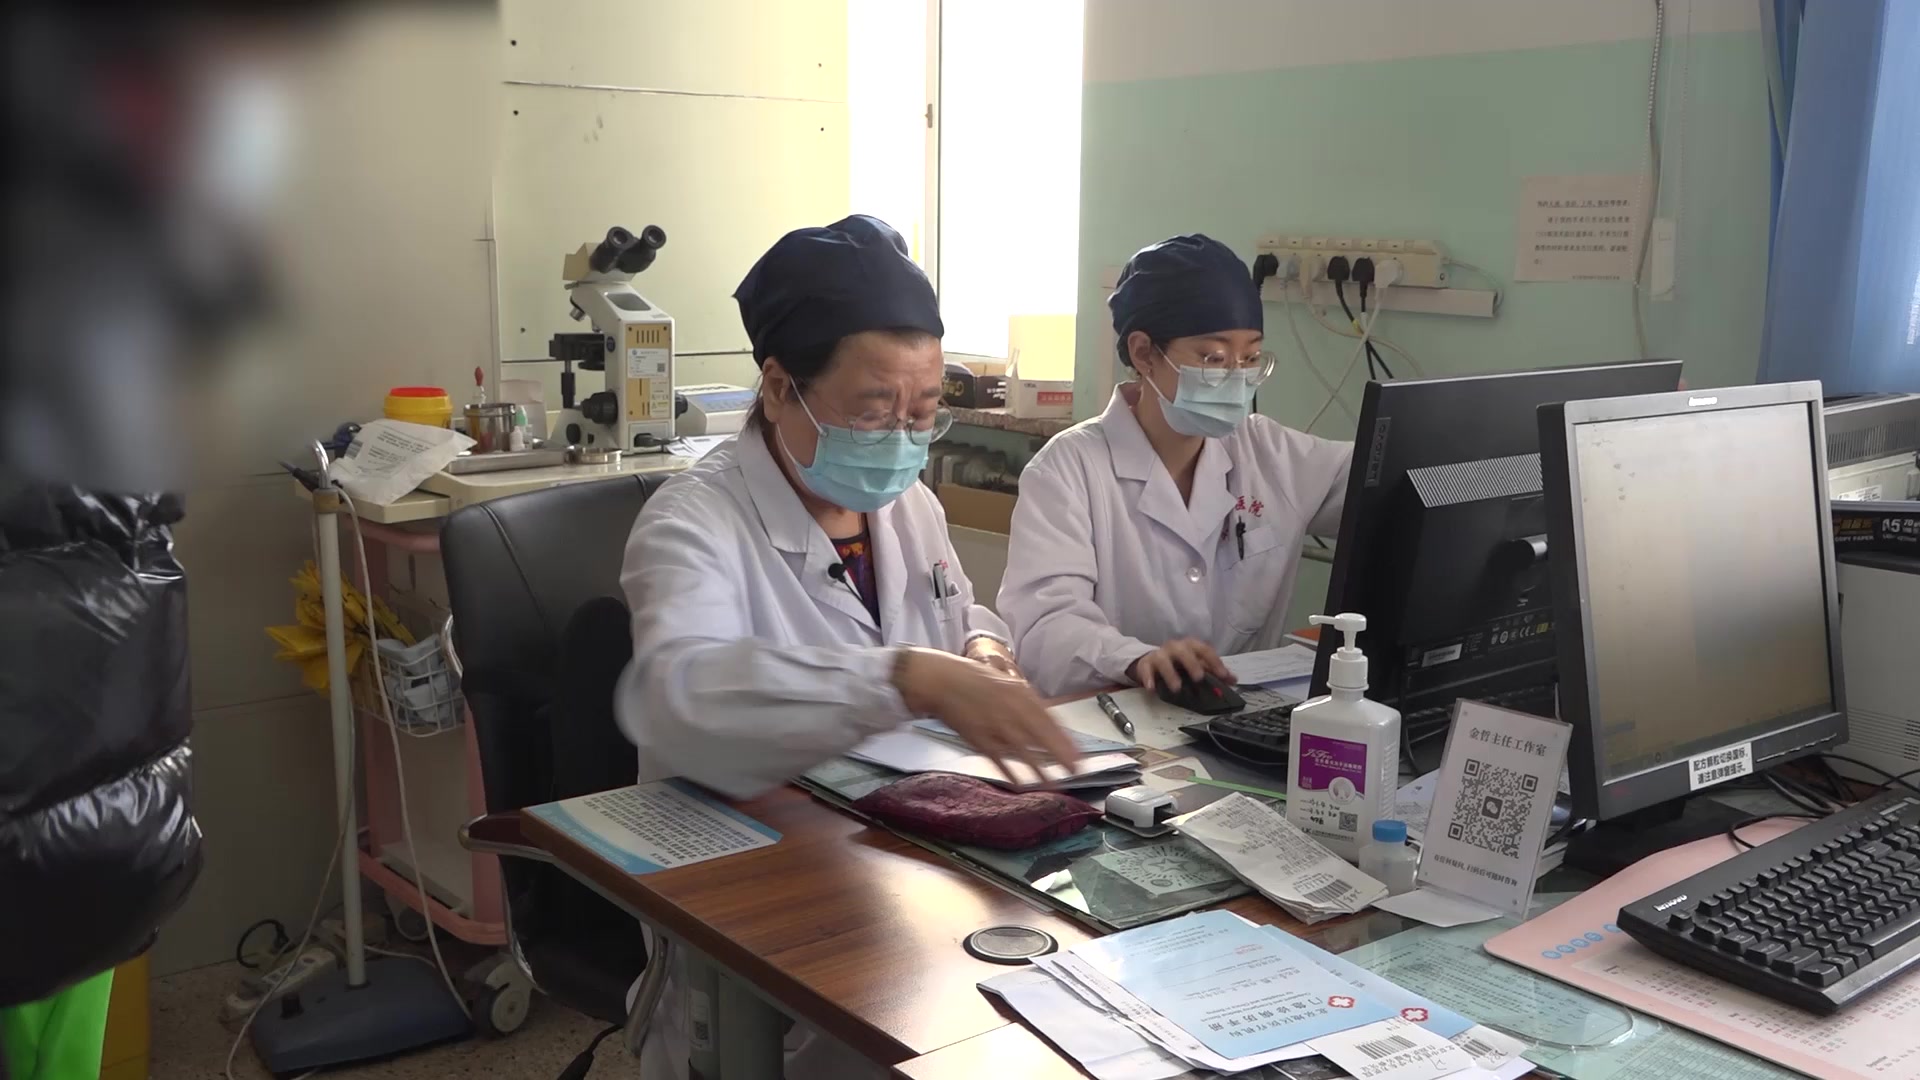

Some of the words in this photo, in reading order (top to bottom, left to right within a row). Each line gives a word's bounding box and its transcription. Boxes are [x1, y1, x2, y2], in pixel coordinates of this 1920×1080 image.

[1469, 727, 1547, 757] 金哲主任工作室
